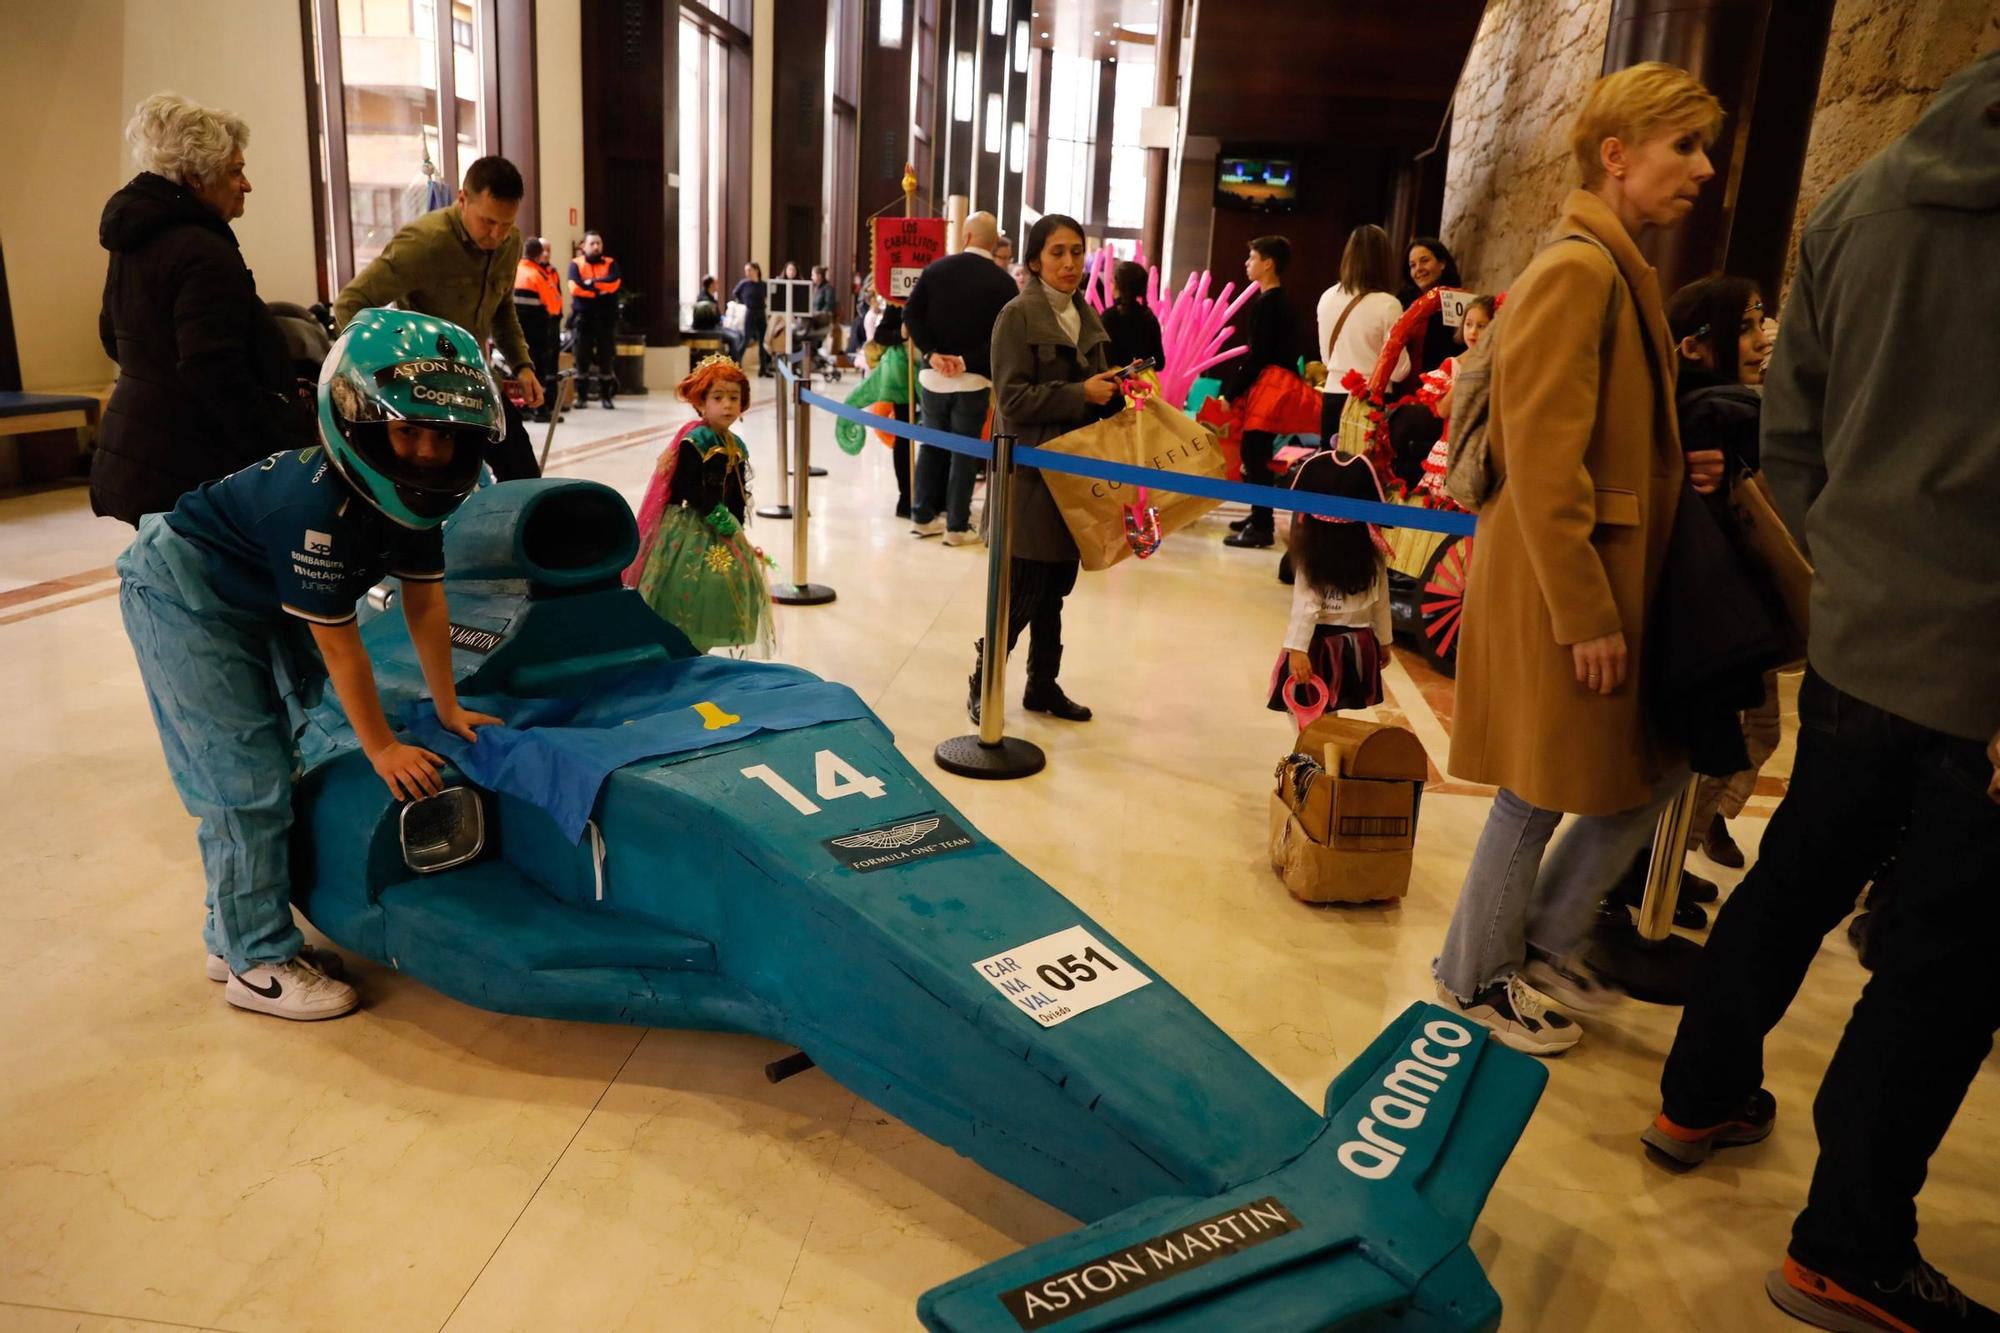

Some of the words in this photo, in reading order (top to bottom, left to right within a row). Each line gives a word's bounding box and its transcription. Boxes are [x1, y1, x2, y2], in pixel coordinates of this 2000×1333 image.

[902, 221, 917, 233] LOS
[1455, 301, 1463, 317] 0
[394, 361, 447, 379] ASTON
[454, 364, 486, 383] MAR
[413, 385, 483, 411] Cognizant
[452, 628, 501, 650] MARTIN
[740, 749, 887, 815] 14
[852, 851, 910, 869] FORMULA
[938, 837, 971, 849] TEAM
[983, 957, 1021, 978] CAR
[1036, 946, 1119, 991] 051
[1000, 977, 1031, 996] NA
[1018, 991, 1058, 1011] VAL
[1038, 1005, 1072, 1023] Oviedo
[1337, 1020, 1472, 1180] aramco
[1024, 1253, 1146, 1319] ASTON
[1145, 1202, 1287, 1270] MARTIN
